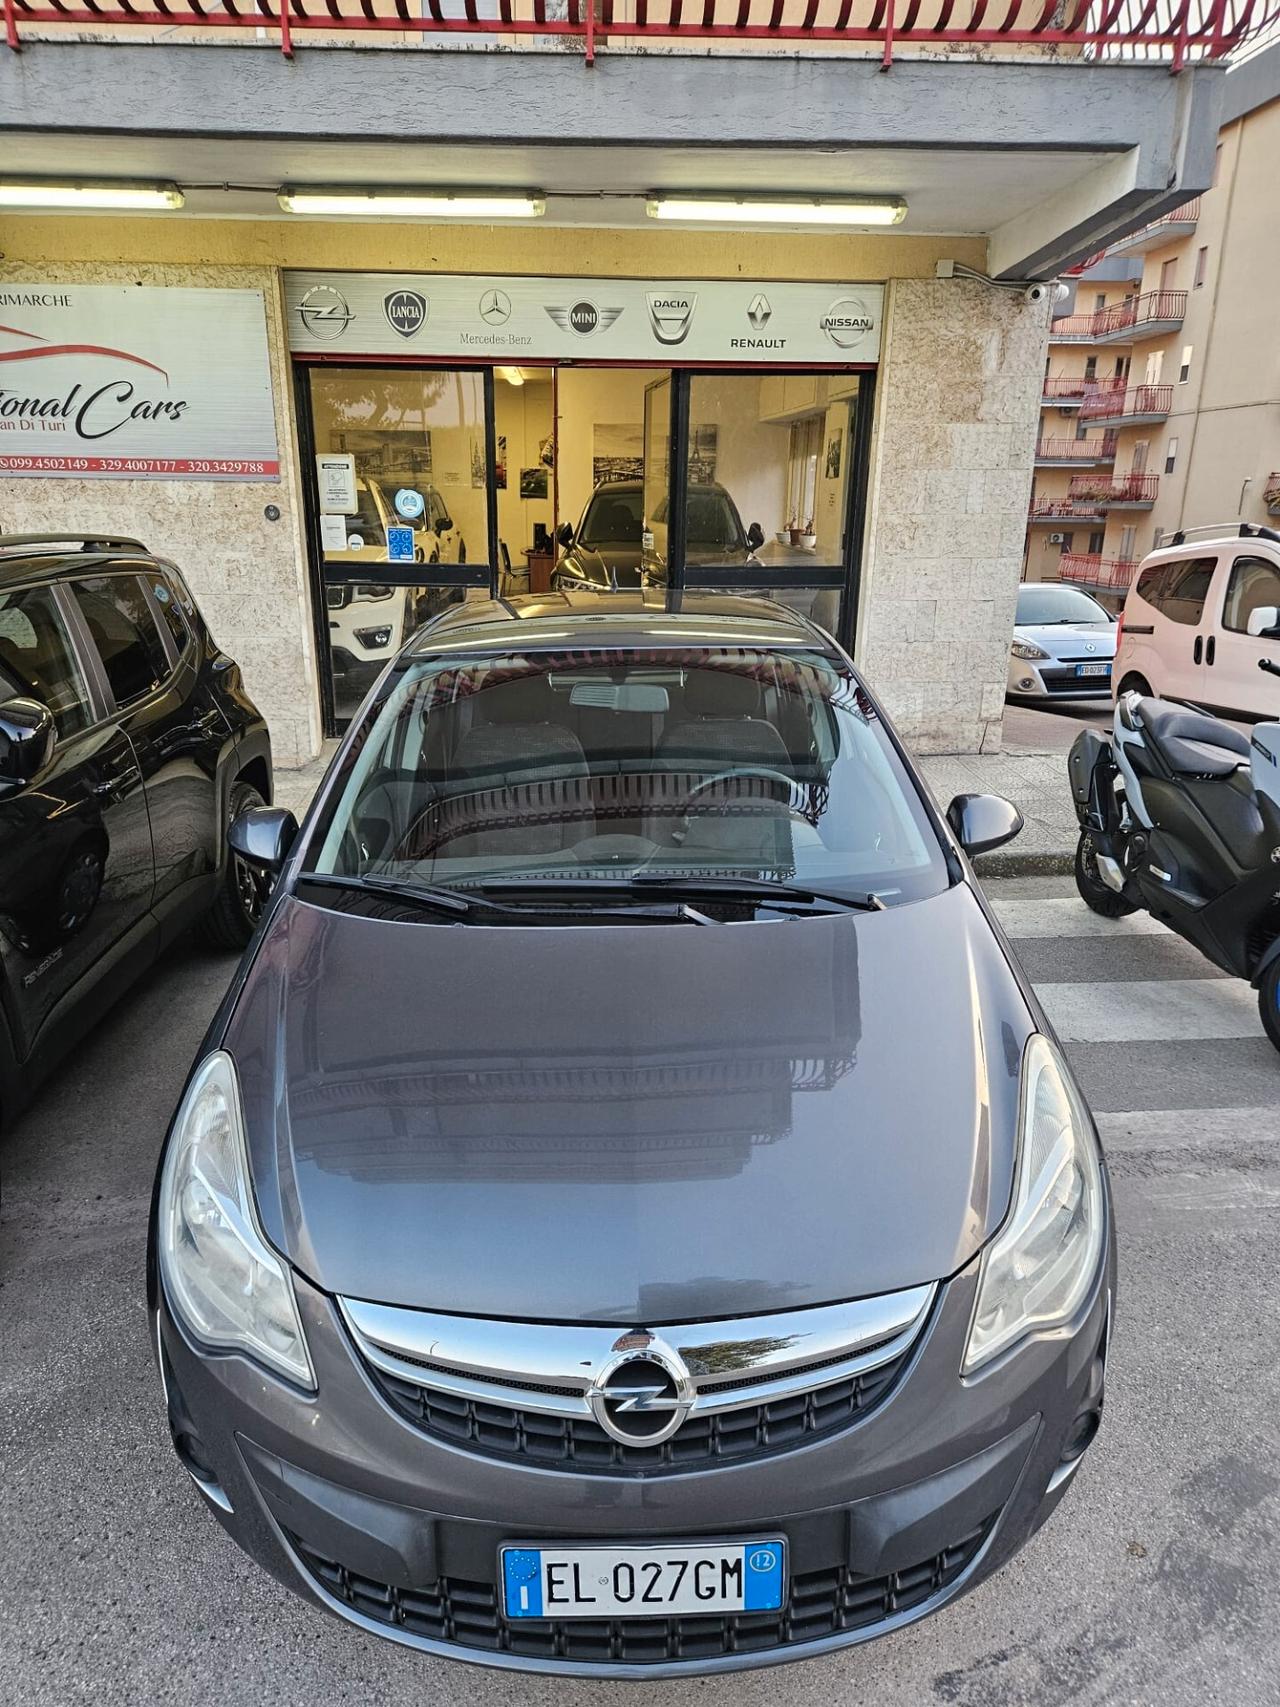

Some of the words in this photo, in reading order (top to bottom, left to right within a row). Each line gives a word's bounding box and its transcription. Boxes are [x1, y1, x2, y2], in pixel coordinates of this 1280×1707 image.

[653, 299, 689, 309] DACIA
[391, 306, 420, 318] LANCIA
[570, 311, 596, 324] MINI
[825, 318, 870, 328] NISSAN
[460, 333, 532, 345] Mercedes-Benz
[730, 338, 786, 349] RENAULT
[75, 380, 190, 439] Cars
[20, 418, 35, 431] Di
[38, 418, 66, 432] Turi
[10, 458, 89, 471] 099.4502149
[100, 459, 176, 472] 329.4007177
[188, 460, 264, 473] 320.3429788
[756, 1554, 770, 1567] 12
[546, 1562, 597, 1603] EL
[612, 1557, 743, 1603] 027GM
